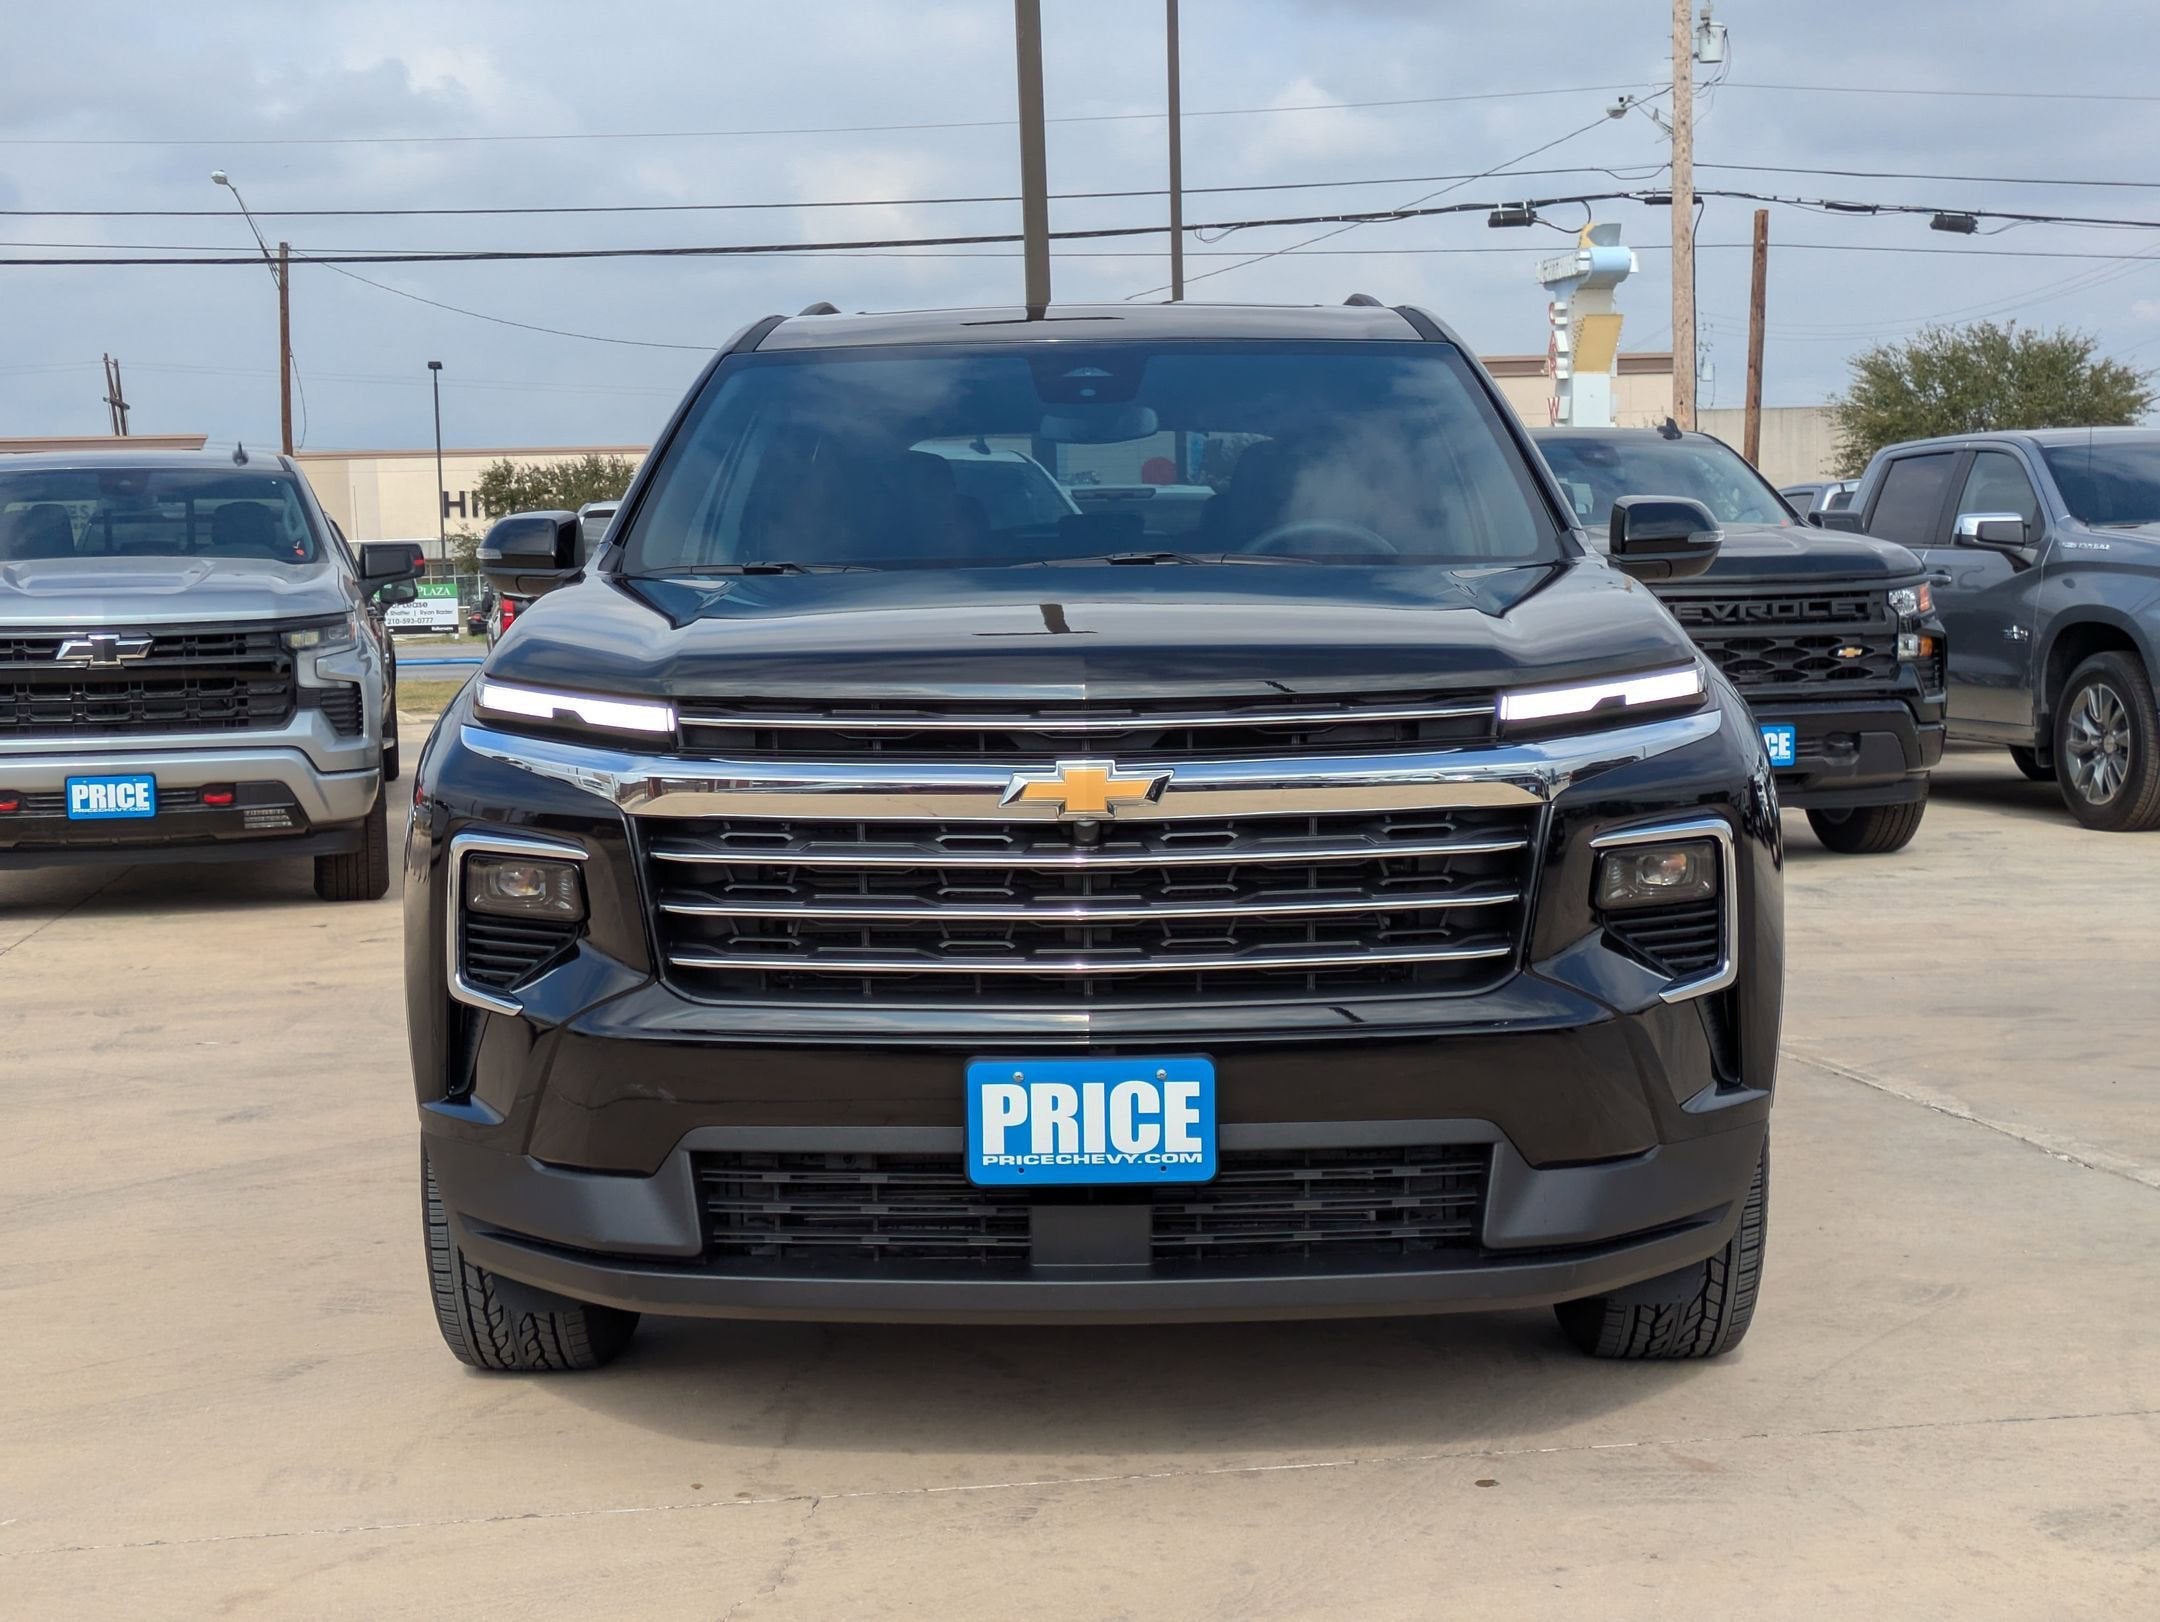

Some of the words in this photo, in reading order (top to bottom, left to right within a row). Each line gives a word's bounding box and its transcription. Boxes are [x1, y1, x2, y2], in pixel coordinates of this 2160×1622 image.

[387, 617, 434, 625] 210-593-0777
[1669, 599, 1880, 621] EVROLET
[71, 782, 150, 809] PRICE
[981, 1080, 1203, 1155] PRICE
[982, 1153, 1203, 1166] PRICECHEVY.COM
